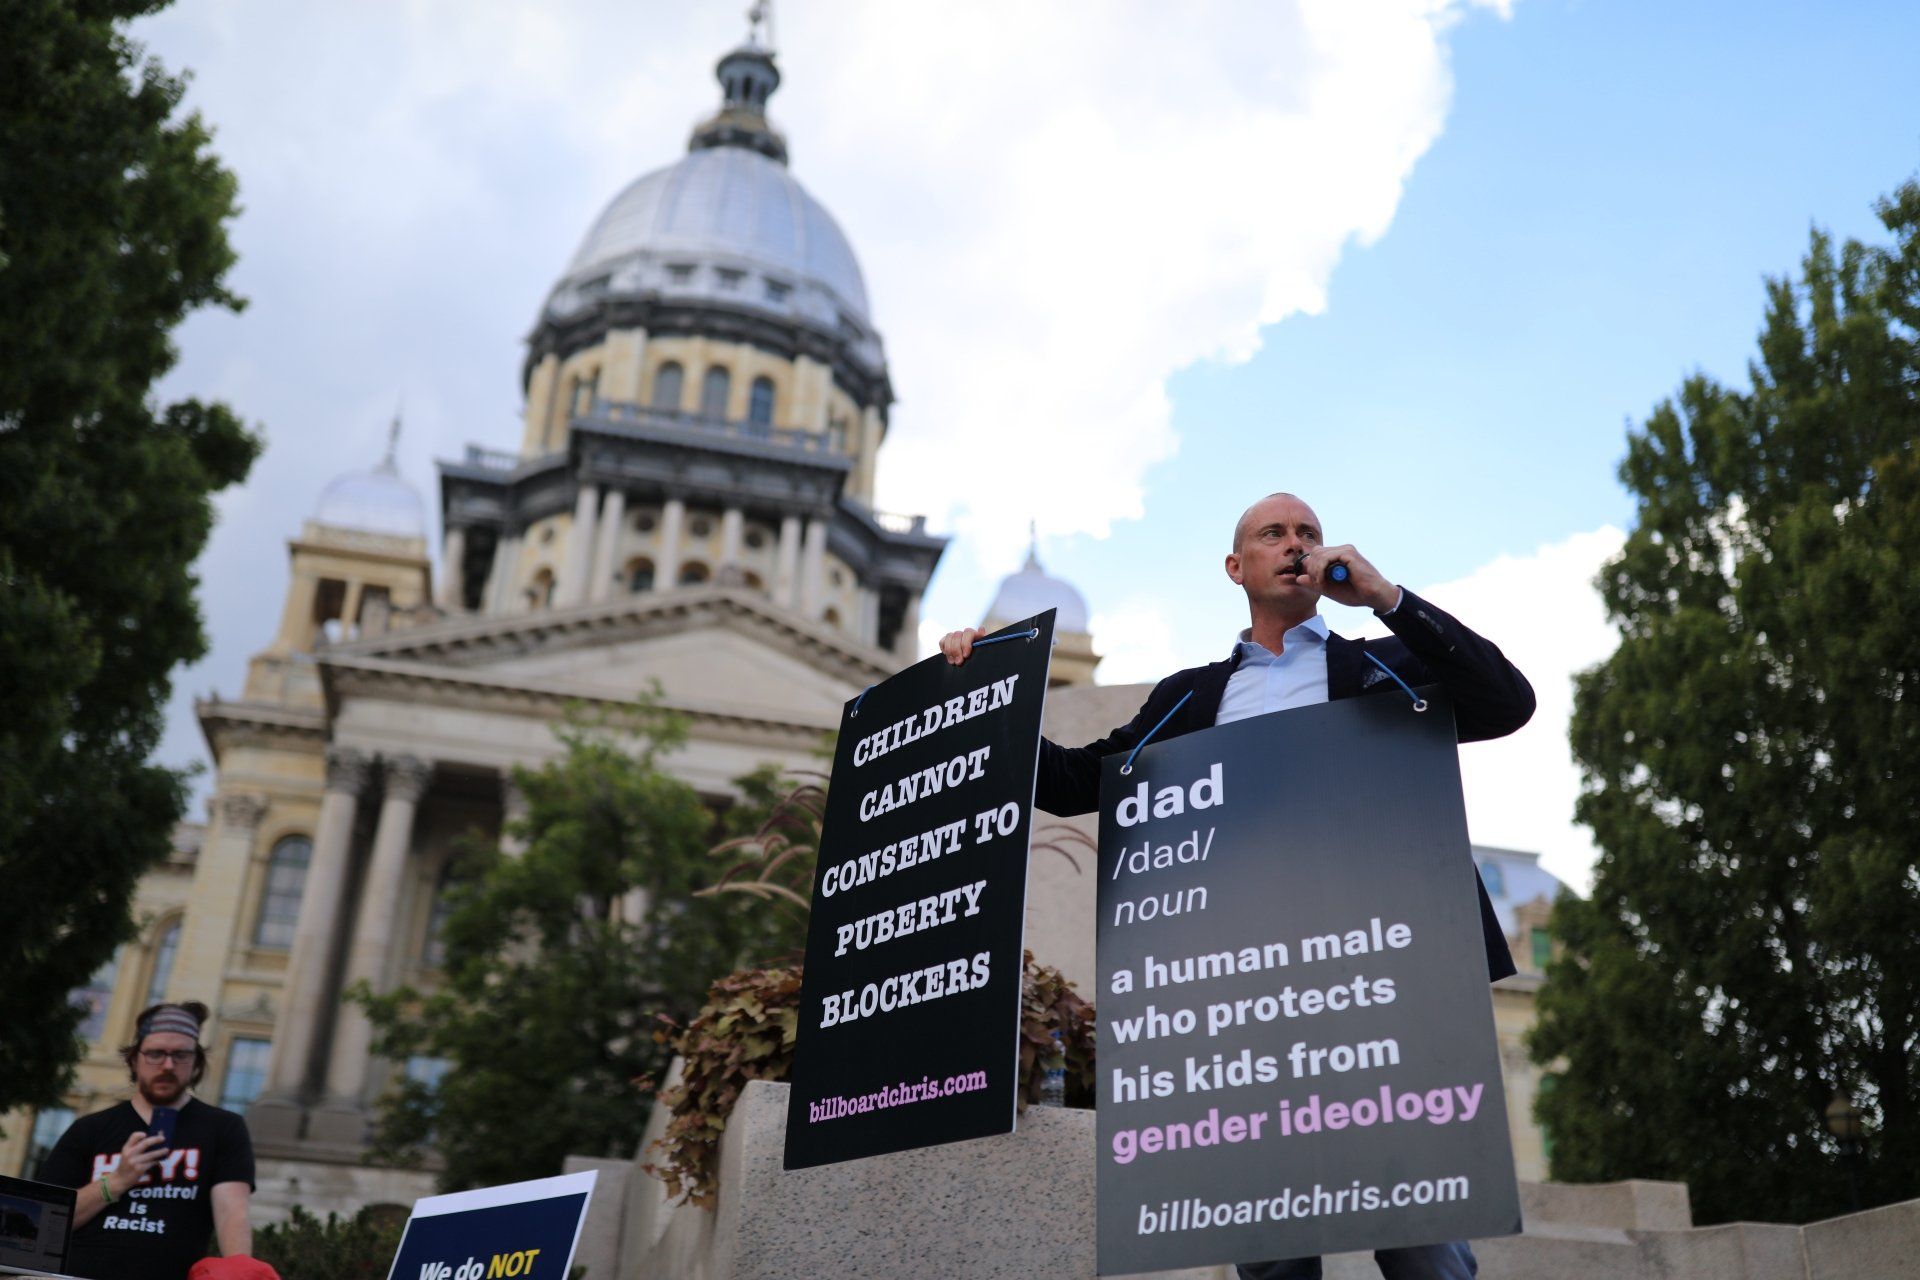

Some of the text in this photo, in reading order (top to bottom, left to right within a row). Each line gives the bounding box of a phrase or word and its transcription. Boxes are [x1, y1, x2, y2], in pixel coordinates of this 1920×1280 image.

[853, 674, 1019, 767] CHILDREN
[859, 746, 991, 822] CANNOT
[1115, 762, 1224, 827] dad
[821, 801, 1020, 897] CONSENT TO
[1112, 827, 1215, 879] /dad/
[834, 880, 987, 957] PUBERTY
[1113, 886, 1207, 926] noun
[1110, 917, 1413, 995] a human male
[819, 951, 990, 1029] BLOCKERS
[1111, 975, 1396, 1044] who protects
[809, 1070, 987, 1123] billboardchris.com
[1112, 1038, 1400, 1103] his kids from
[1112, 1083, 1484, 1164] gender ideology
[92, 1148, 200, 1184] HY!
[103, 1216, 165, 1234] Racist
[129, 1201, 147, 1214] Is
[1137, 1175, 1469, 1235] billboardchris.com
[419, 1249, 540, 1280] We do NOT
